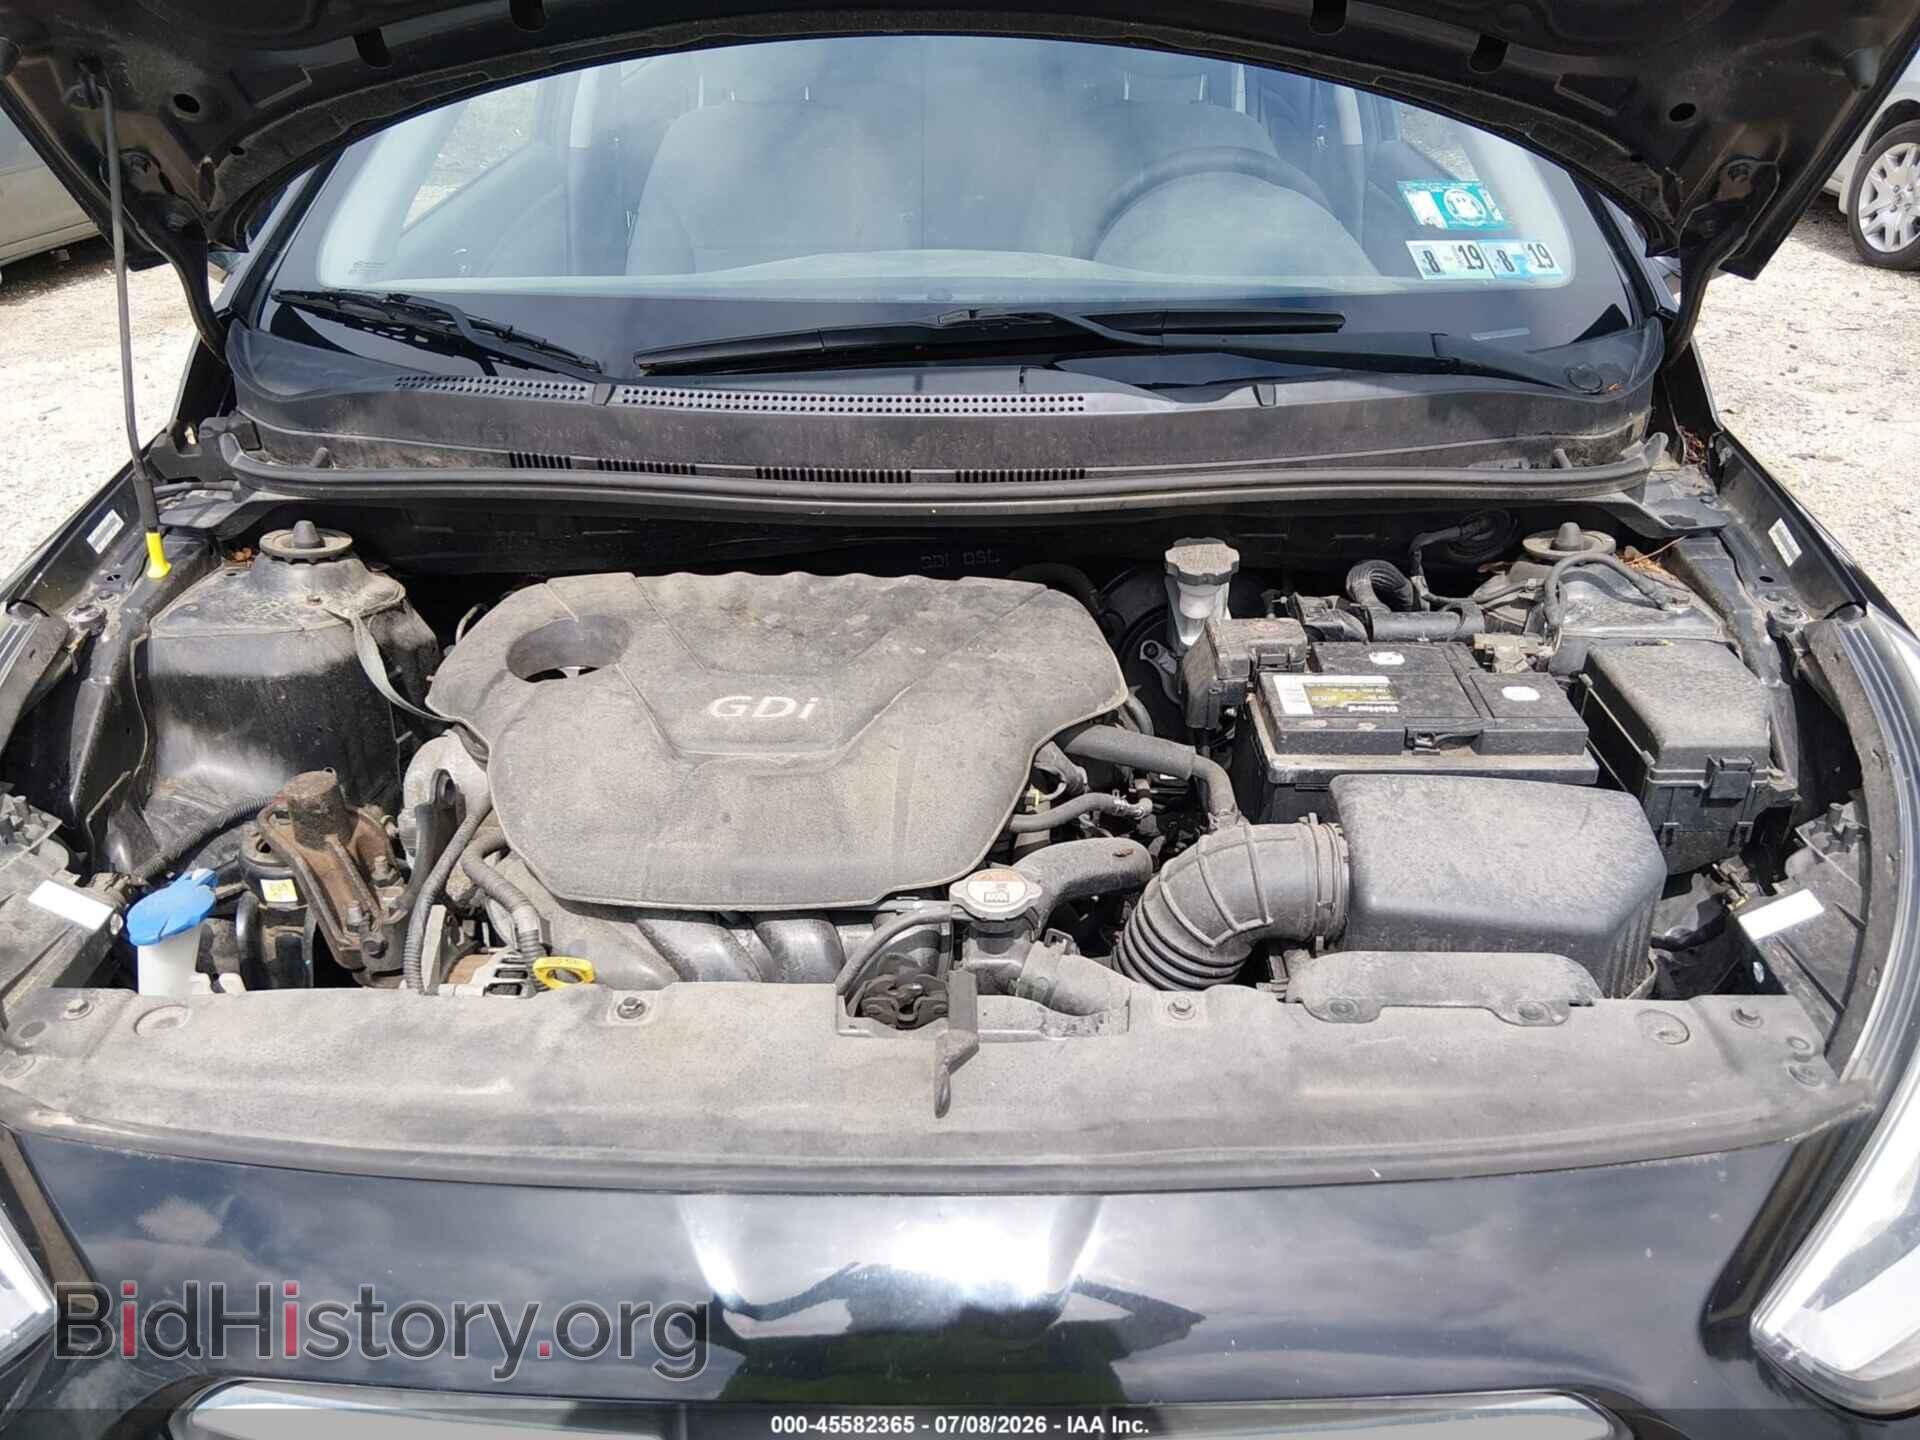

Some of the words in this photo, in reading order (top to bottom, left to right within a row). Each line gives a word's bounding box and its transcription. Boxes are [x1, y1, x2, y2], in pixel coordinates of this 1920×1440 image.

[1424, 250, 1440, 273] 8
[1458, 244, 1485, 270] 19
[1497, 250, 1515, 273] 8
[1528, 243, 1554, 269] 19
[709, 695, 819, 719] GDi
